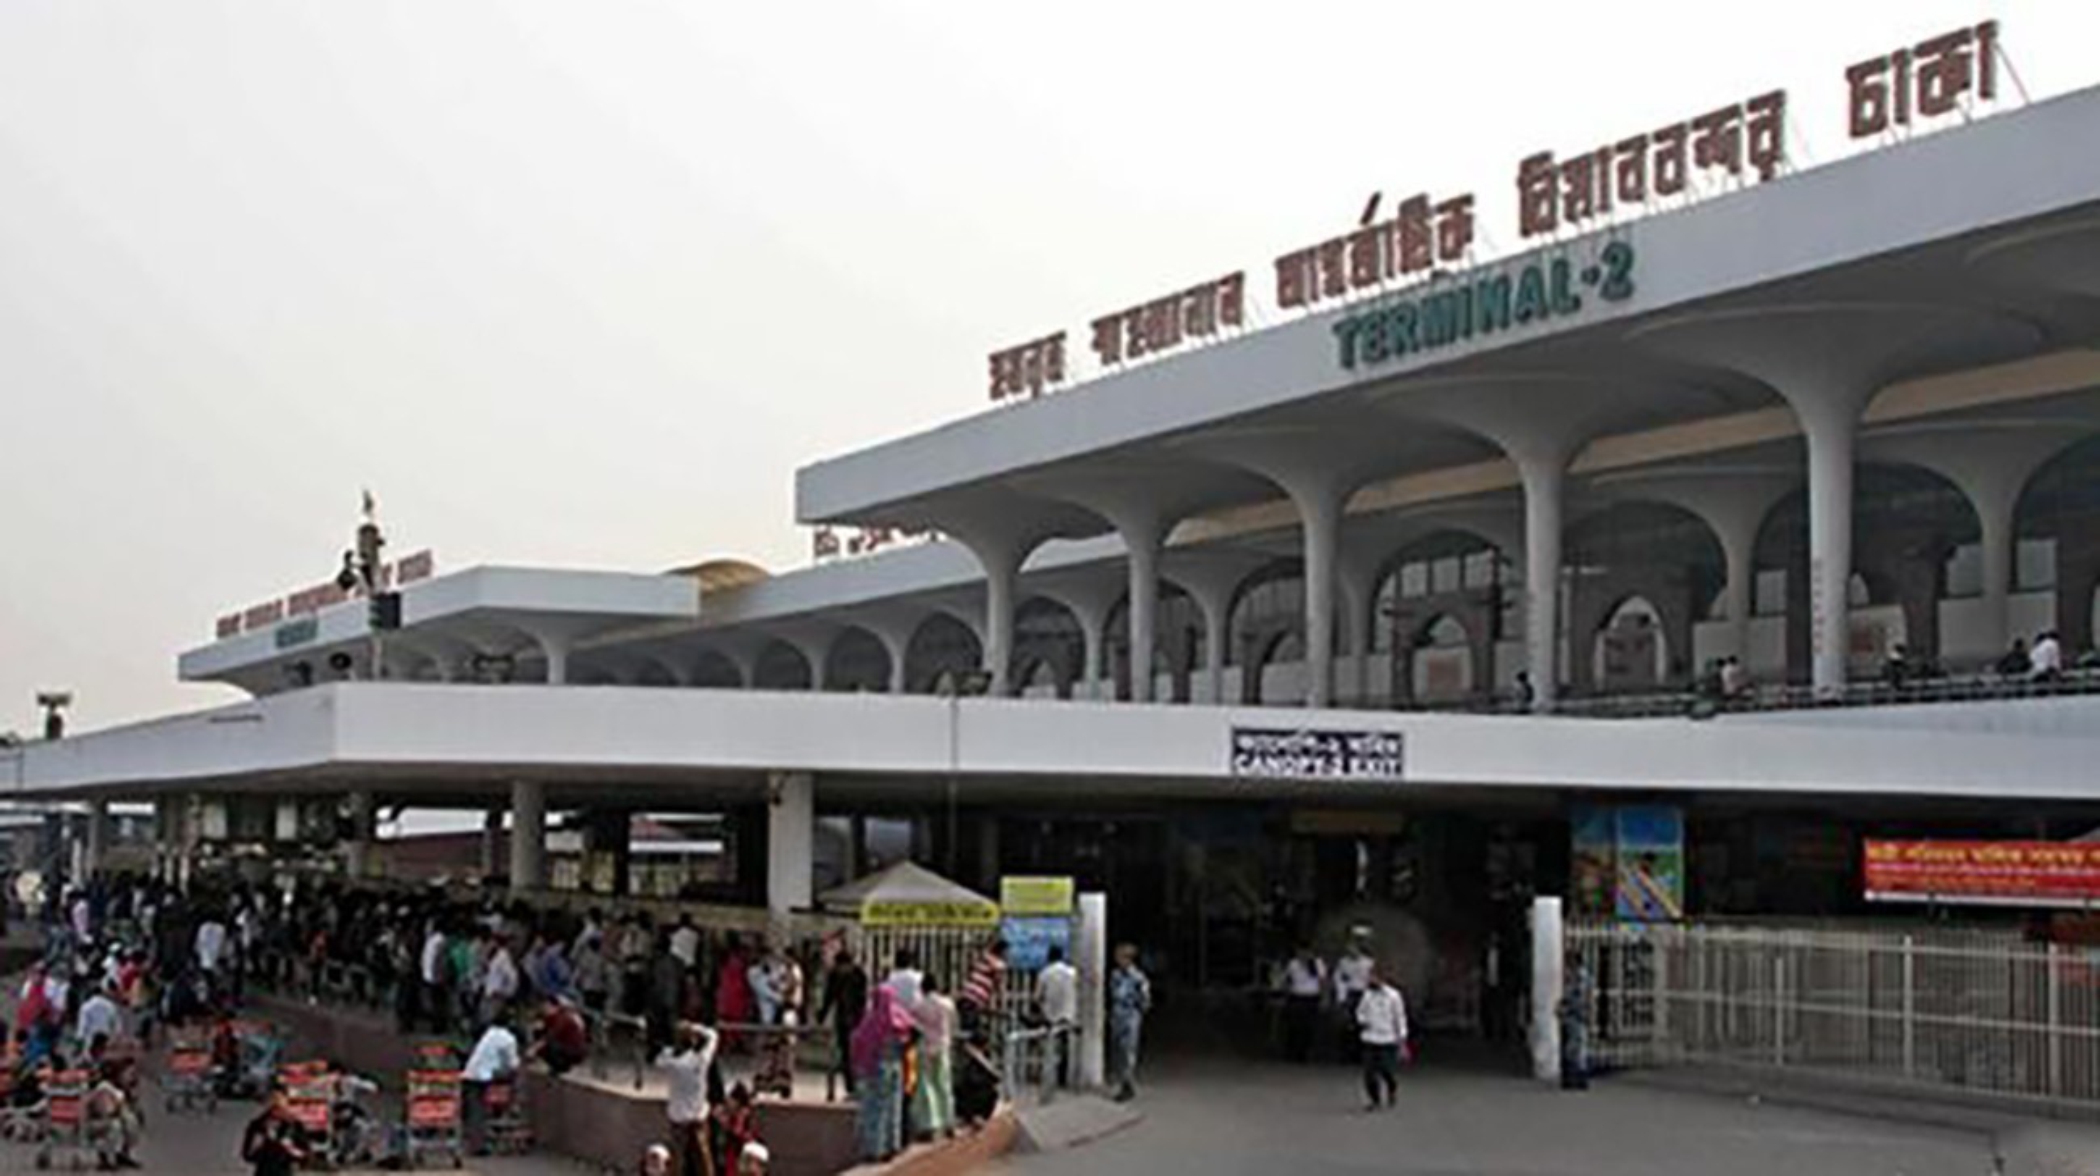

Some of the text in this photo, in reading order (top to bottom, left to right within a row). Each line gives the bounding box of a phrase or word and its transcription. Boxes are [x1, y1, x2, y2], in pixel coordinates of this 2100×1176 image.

[1517, 88, 1786, 238] বিমানবন্দর
[1846, 20, 1998, 138] ঢাকা
[1331, 240, 1636, 370] TERMINAL-2
[1350, 756, 1403, 777] EXIT
